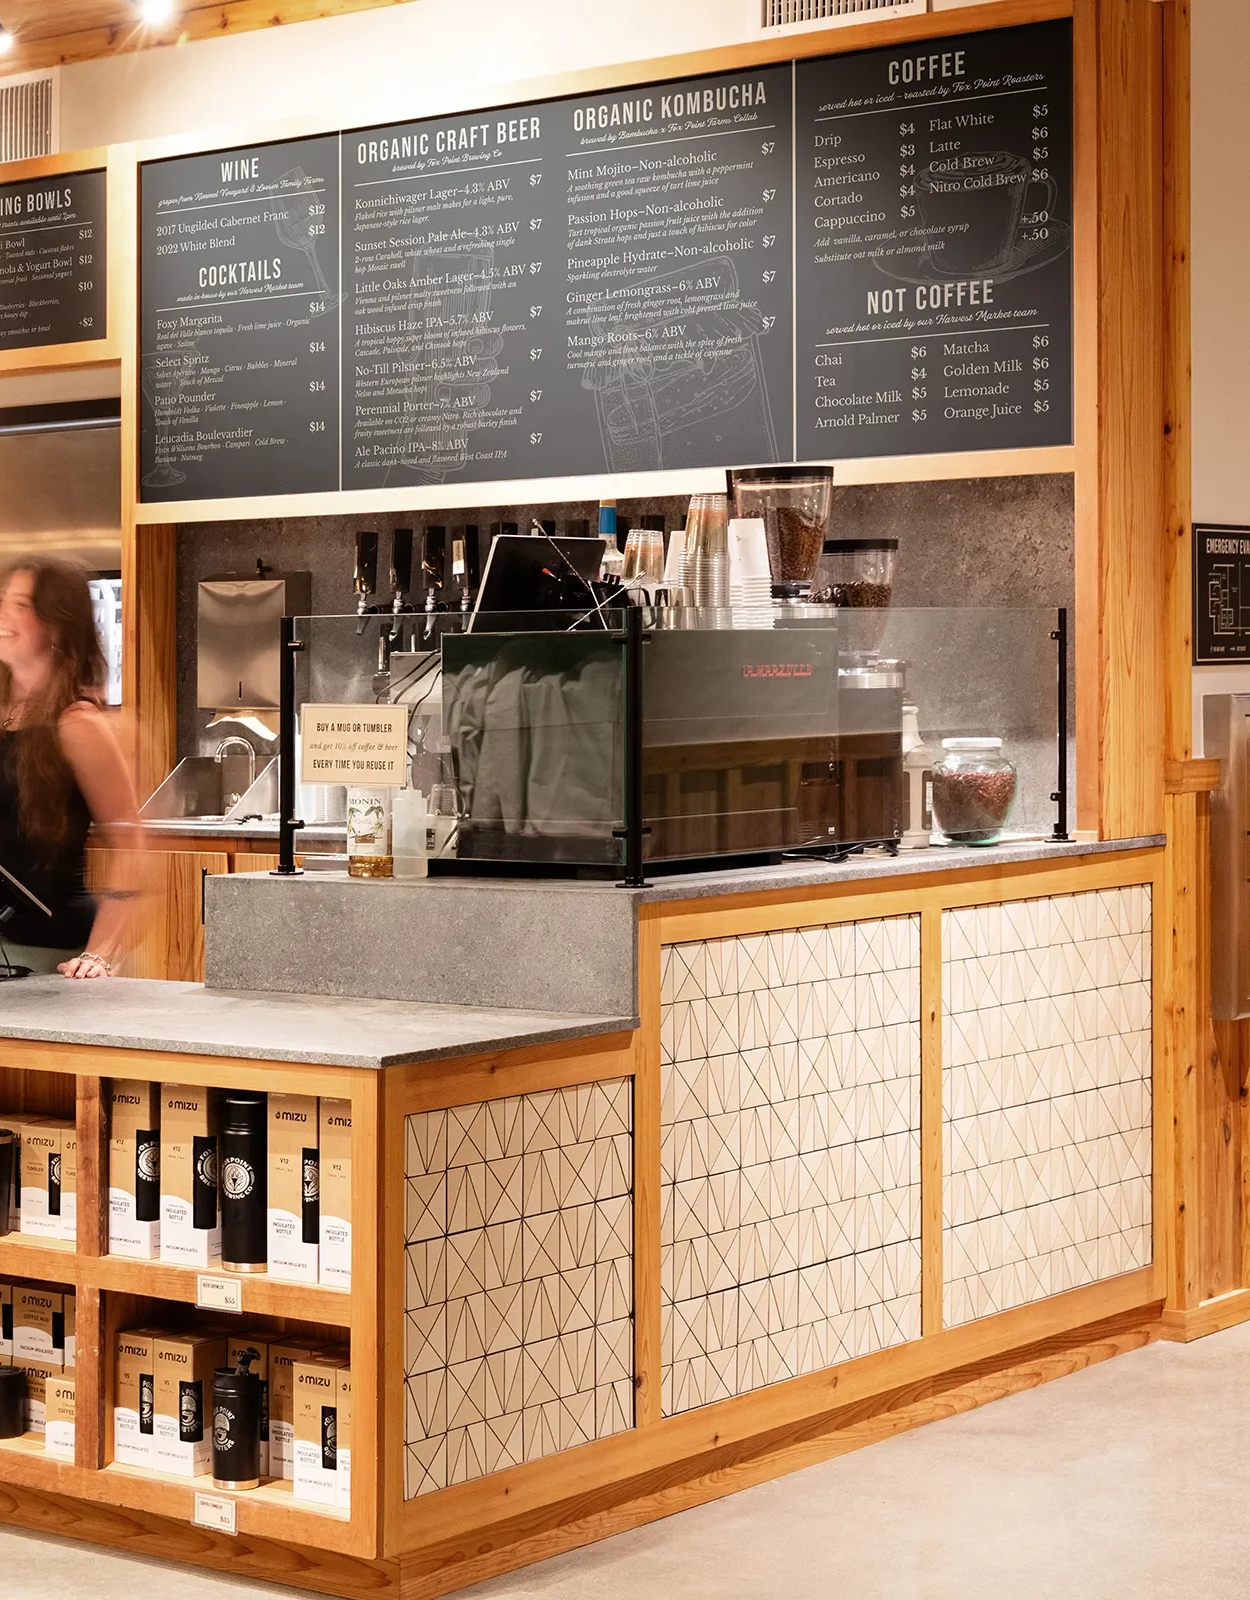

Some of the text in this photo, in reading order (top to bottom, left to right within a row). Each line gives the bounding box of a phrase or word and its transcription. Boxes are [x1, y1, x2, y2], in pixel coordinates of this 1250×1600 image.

[889, 51, 964, 84] COFFEE
[574, 82, 766, 131] ORGANIC KOMBUCHA
[930, 105, 1048, 131] Flat White $5
[358, 117, 539, 164] ORGANIC CRAFT BEER
[815, 123, 915, 147] Drip $4
[930, 127, 1048, 152] Latte $6
[814, 144, 914, 168] Espresso $3
[930, 147, 1048, 172] Cold Brew $5
[221, 158, 258, 182] WINE
[814, 165, 915, 187] Americano $4
[28, 189, 71, 212] BOWLS
[356, 193, 427, 209] Konnichiwager
[487, 179, 510, 191] ABV
[530, 174, 542, 186] $7
[815, 185, 915, 207] Cortado $4
[156, 204, 325, 236] 2017 Ungilded Cabernet Franc $12
[815, 206, 915, 229] Cappuccino $5
[157, 224, 325, 255] 2022 White Blend $12
[17, 262, 24, 273] &
[26, 262, 50, 275] Yogurt
[53, 257, 72, 268] Bowl
[79, 255, 92, 264] $12
[200, 258, 280, 289] COCKTAILS
[567, 272, 599, 282] Sparkling
[601, 268, 636, 277] electrolyte
[79, 281, 92, 291] $10
[567, 292, 603, 304] Ginger
[696, 277, 720, 289] ABV
[763, 271, 776, 283] $7
[868, 280, 993, 314] NOT COFFEE
[157, 302, 325, 331] Foxy Margarita $14
[356, 324, 395, 335] Hibiscus
[399, 320, 422, 330] Haze
[471, 311, 493, 323] ABV
[530, 306, 542, 318] $7
[156, 342, 325, 368] Select Spritz $14
[815, 346, 926, 366] Chai $6
[944, 336, 1048, 355] Matcha $6
[815, 368, 926, 387] Tea $4
[944, 357, 1048, 376] Golden Milk $6
[155, 381, 325, 405] Patio Pounder $14
[816, 387, 926, 407] Chocolate Milk $5
[945, 379, 1049, 398] Lemonade $5
[815, 409, 926, 428] Arnold Palmer $5
[944, 400, 1049, 419] Orange Juice $5
[156, 422, 325, 444] Leucadia Boulevardier $14
[1206, 538, 1239, 554] EMERGENCY
[317, 723, 392, 732] BUY A MUG OR TUMBLER
[348, 743, 358, 751] off
[358, 743, 375, 752] coffee
[314, 760, 393, 770] EVERY TIME YOU REUSE IT
